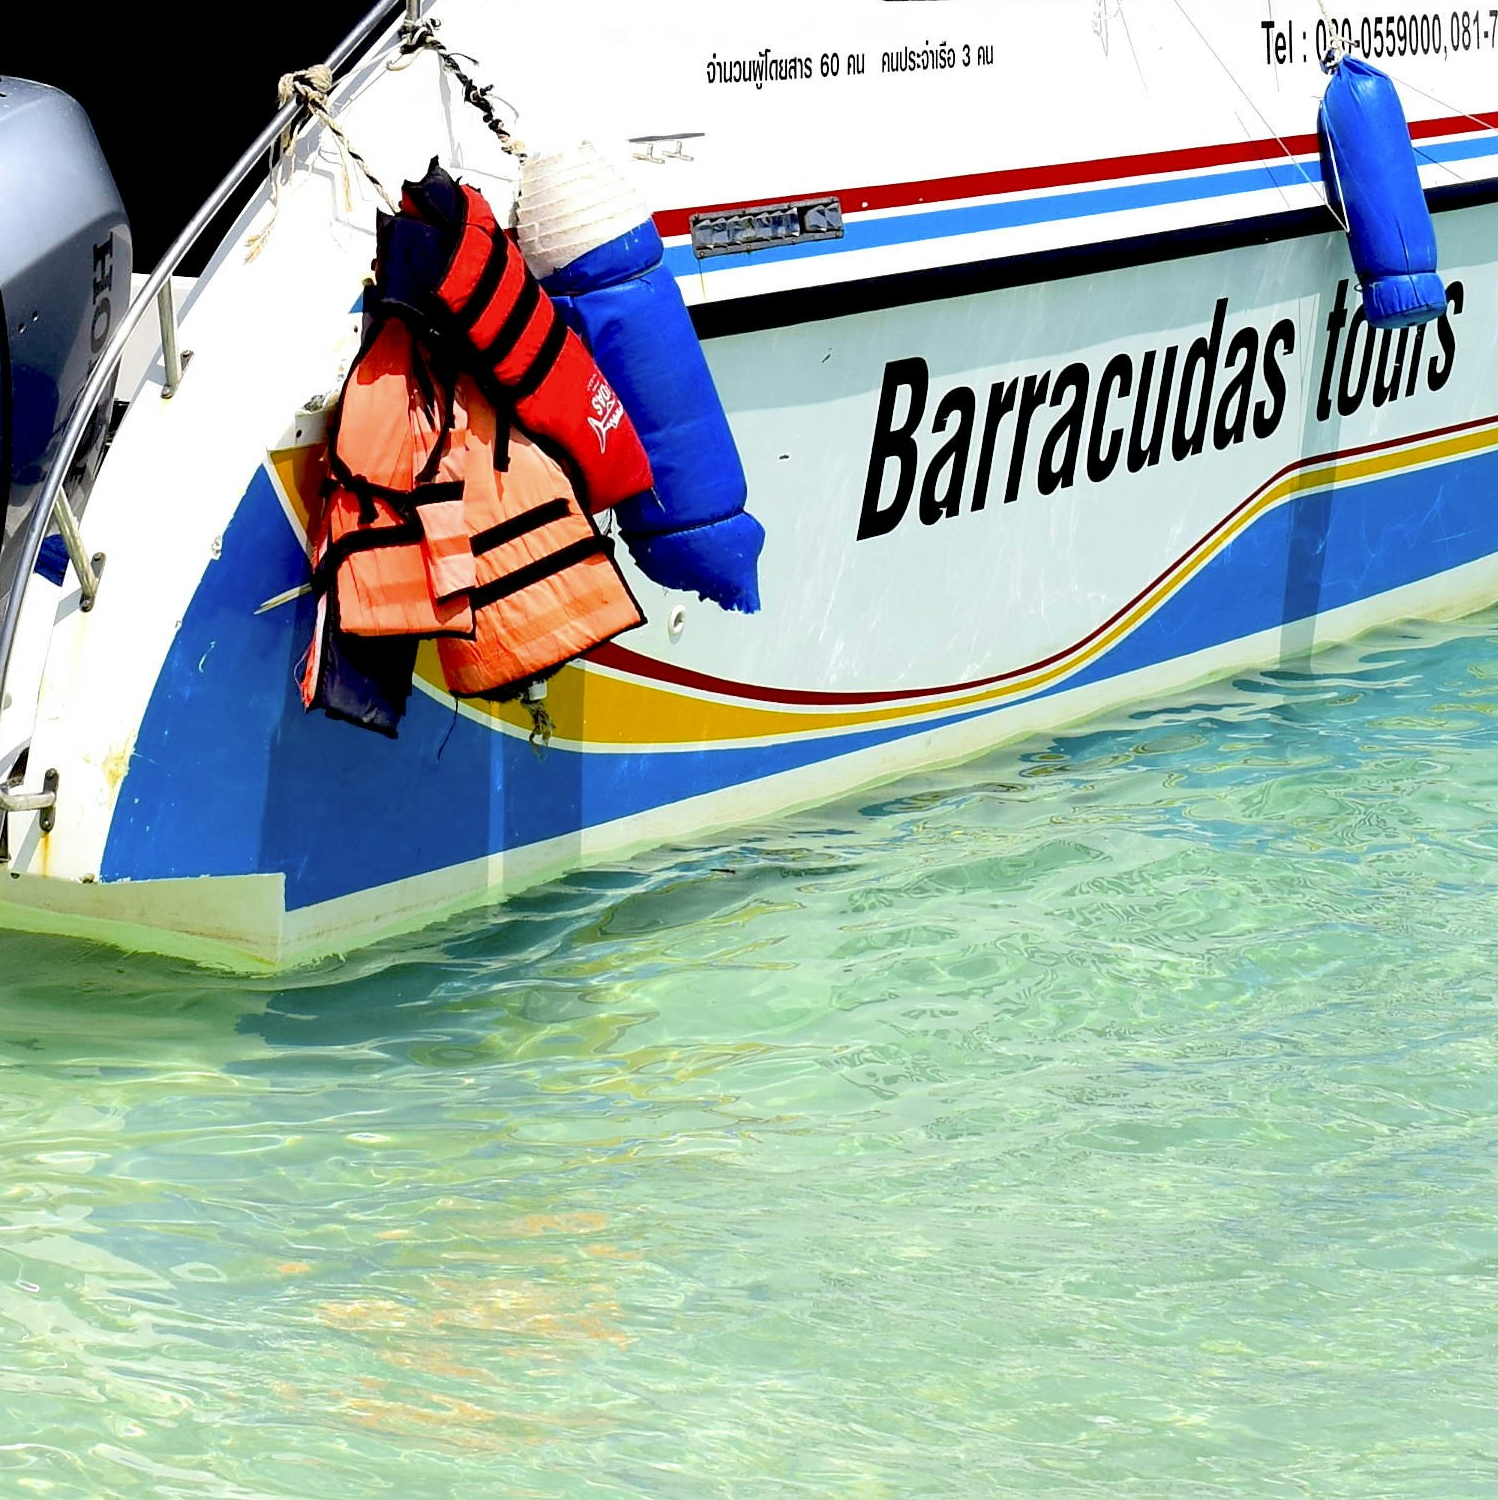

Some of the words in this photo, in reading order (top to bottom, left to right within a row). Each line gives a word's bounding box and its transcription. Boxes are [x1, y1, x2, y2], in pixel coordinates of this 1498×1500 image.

[706, 48, 813, 90] จำนวนผู้โดยสาร
[820, 52, 840, 78] 60
[847, 53, 865, 76] คน
[881, 39, 956, 74] คนประจำเรือ
[962, 43, 971, 67] 3
[977, 44, 994, 66] คน
[1260, 19, 1293, 65] Tel
[856, 297, 1296, 542] Barracudas
[1316, 278, 1465, 422] tours
